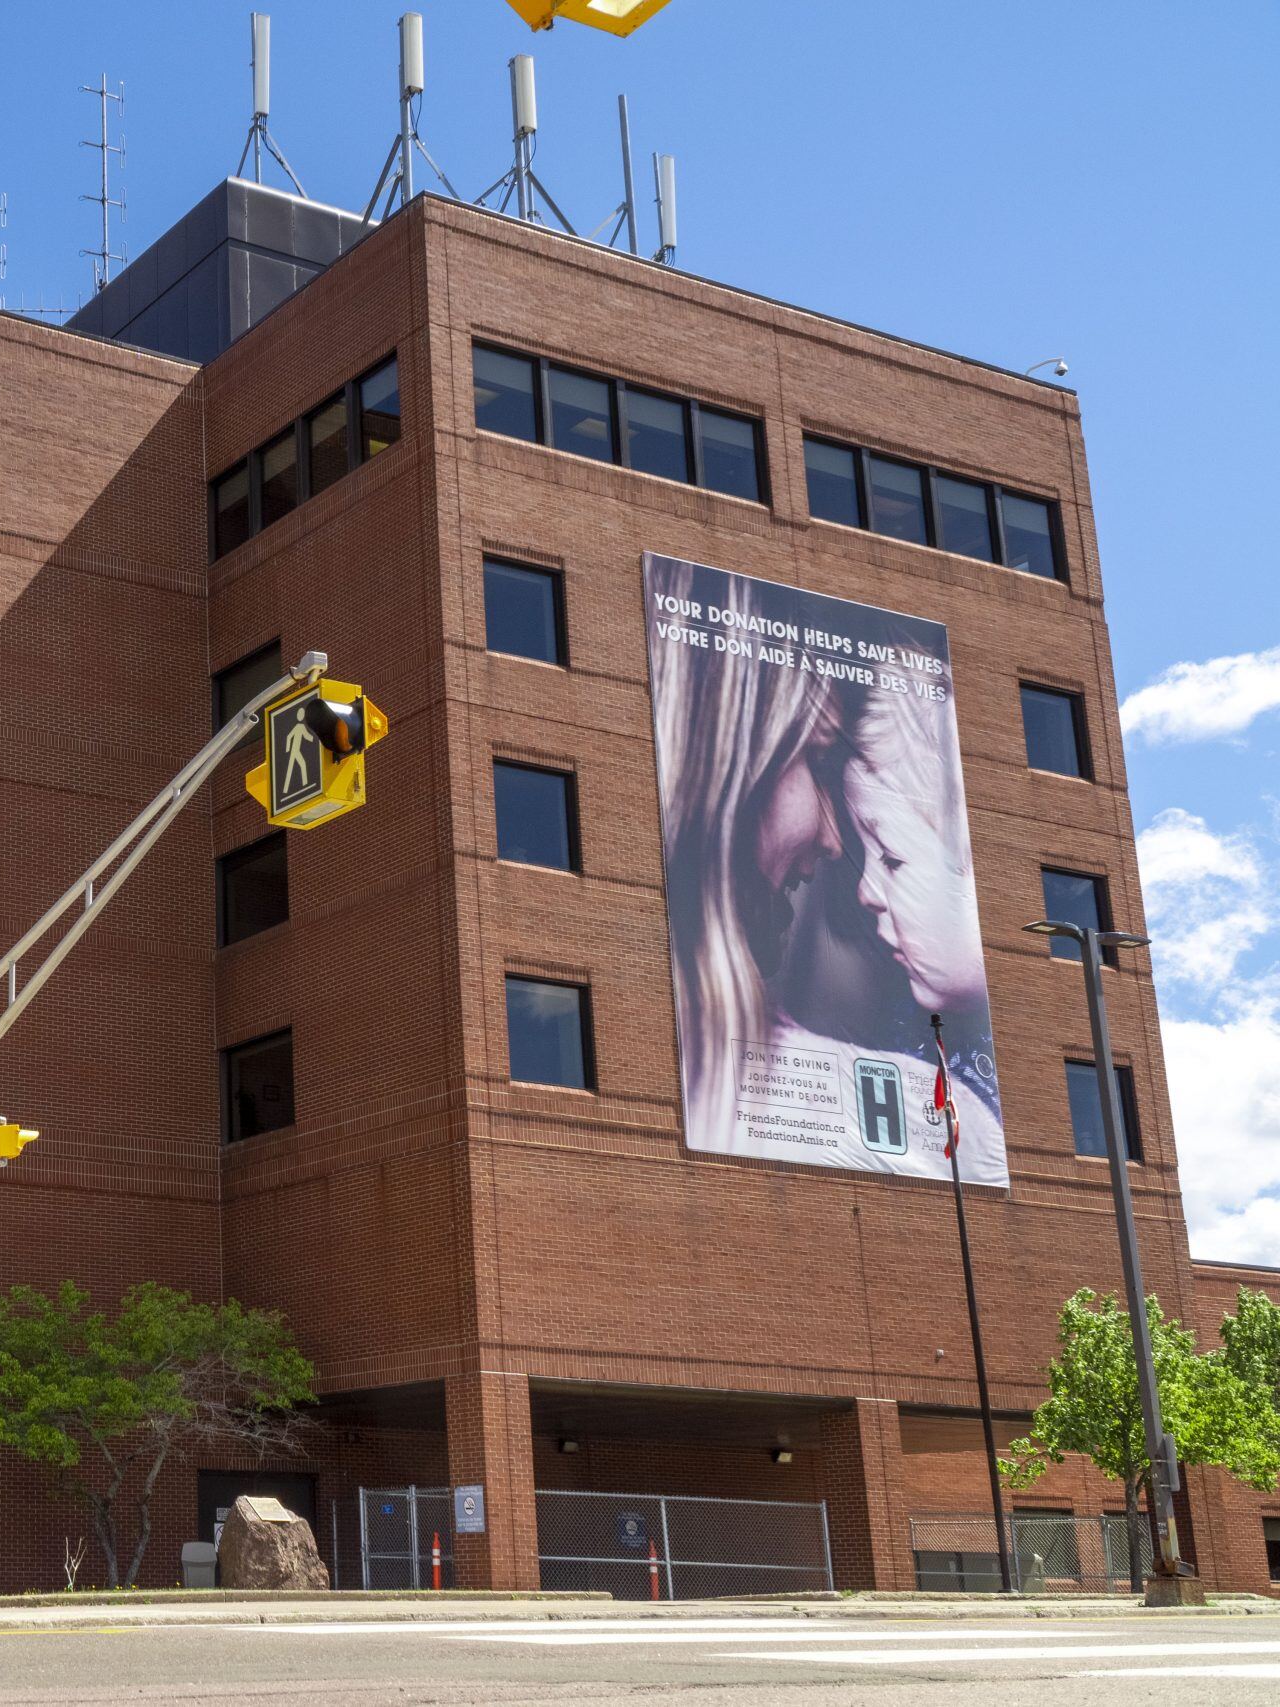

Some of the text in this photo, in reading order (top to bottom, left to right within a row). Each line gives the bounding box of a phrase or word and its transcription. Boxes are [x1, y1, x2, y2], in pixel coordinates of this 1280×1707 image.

[654, 592, 943, 675] YOUR DONATION HELPS SAVE LIVES
[656, 621, 946, 702] VOTRE DON AIDE À SAUVER DES VIES
[741, 1051, 831, 1072] JOIN THE GIVING
[859, 1064, 895, 1079] MONCTON
[748, 1072, 827, 1091] JOIGNEZ-VOUS AU
[740, 1085, 838, 1105] MOUVEMENT DE DONS
[737, 1110, 846, 1134] FriendsFoundation.ca
[861, 1076, 902, 1147] H
[747, 1127, 839, 1148] FondationAmis.ca
